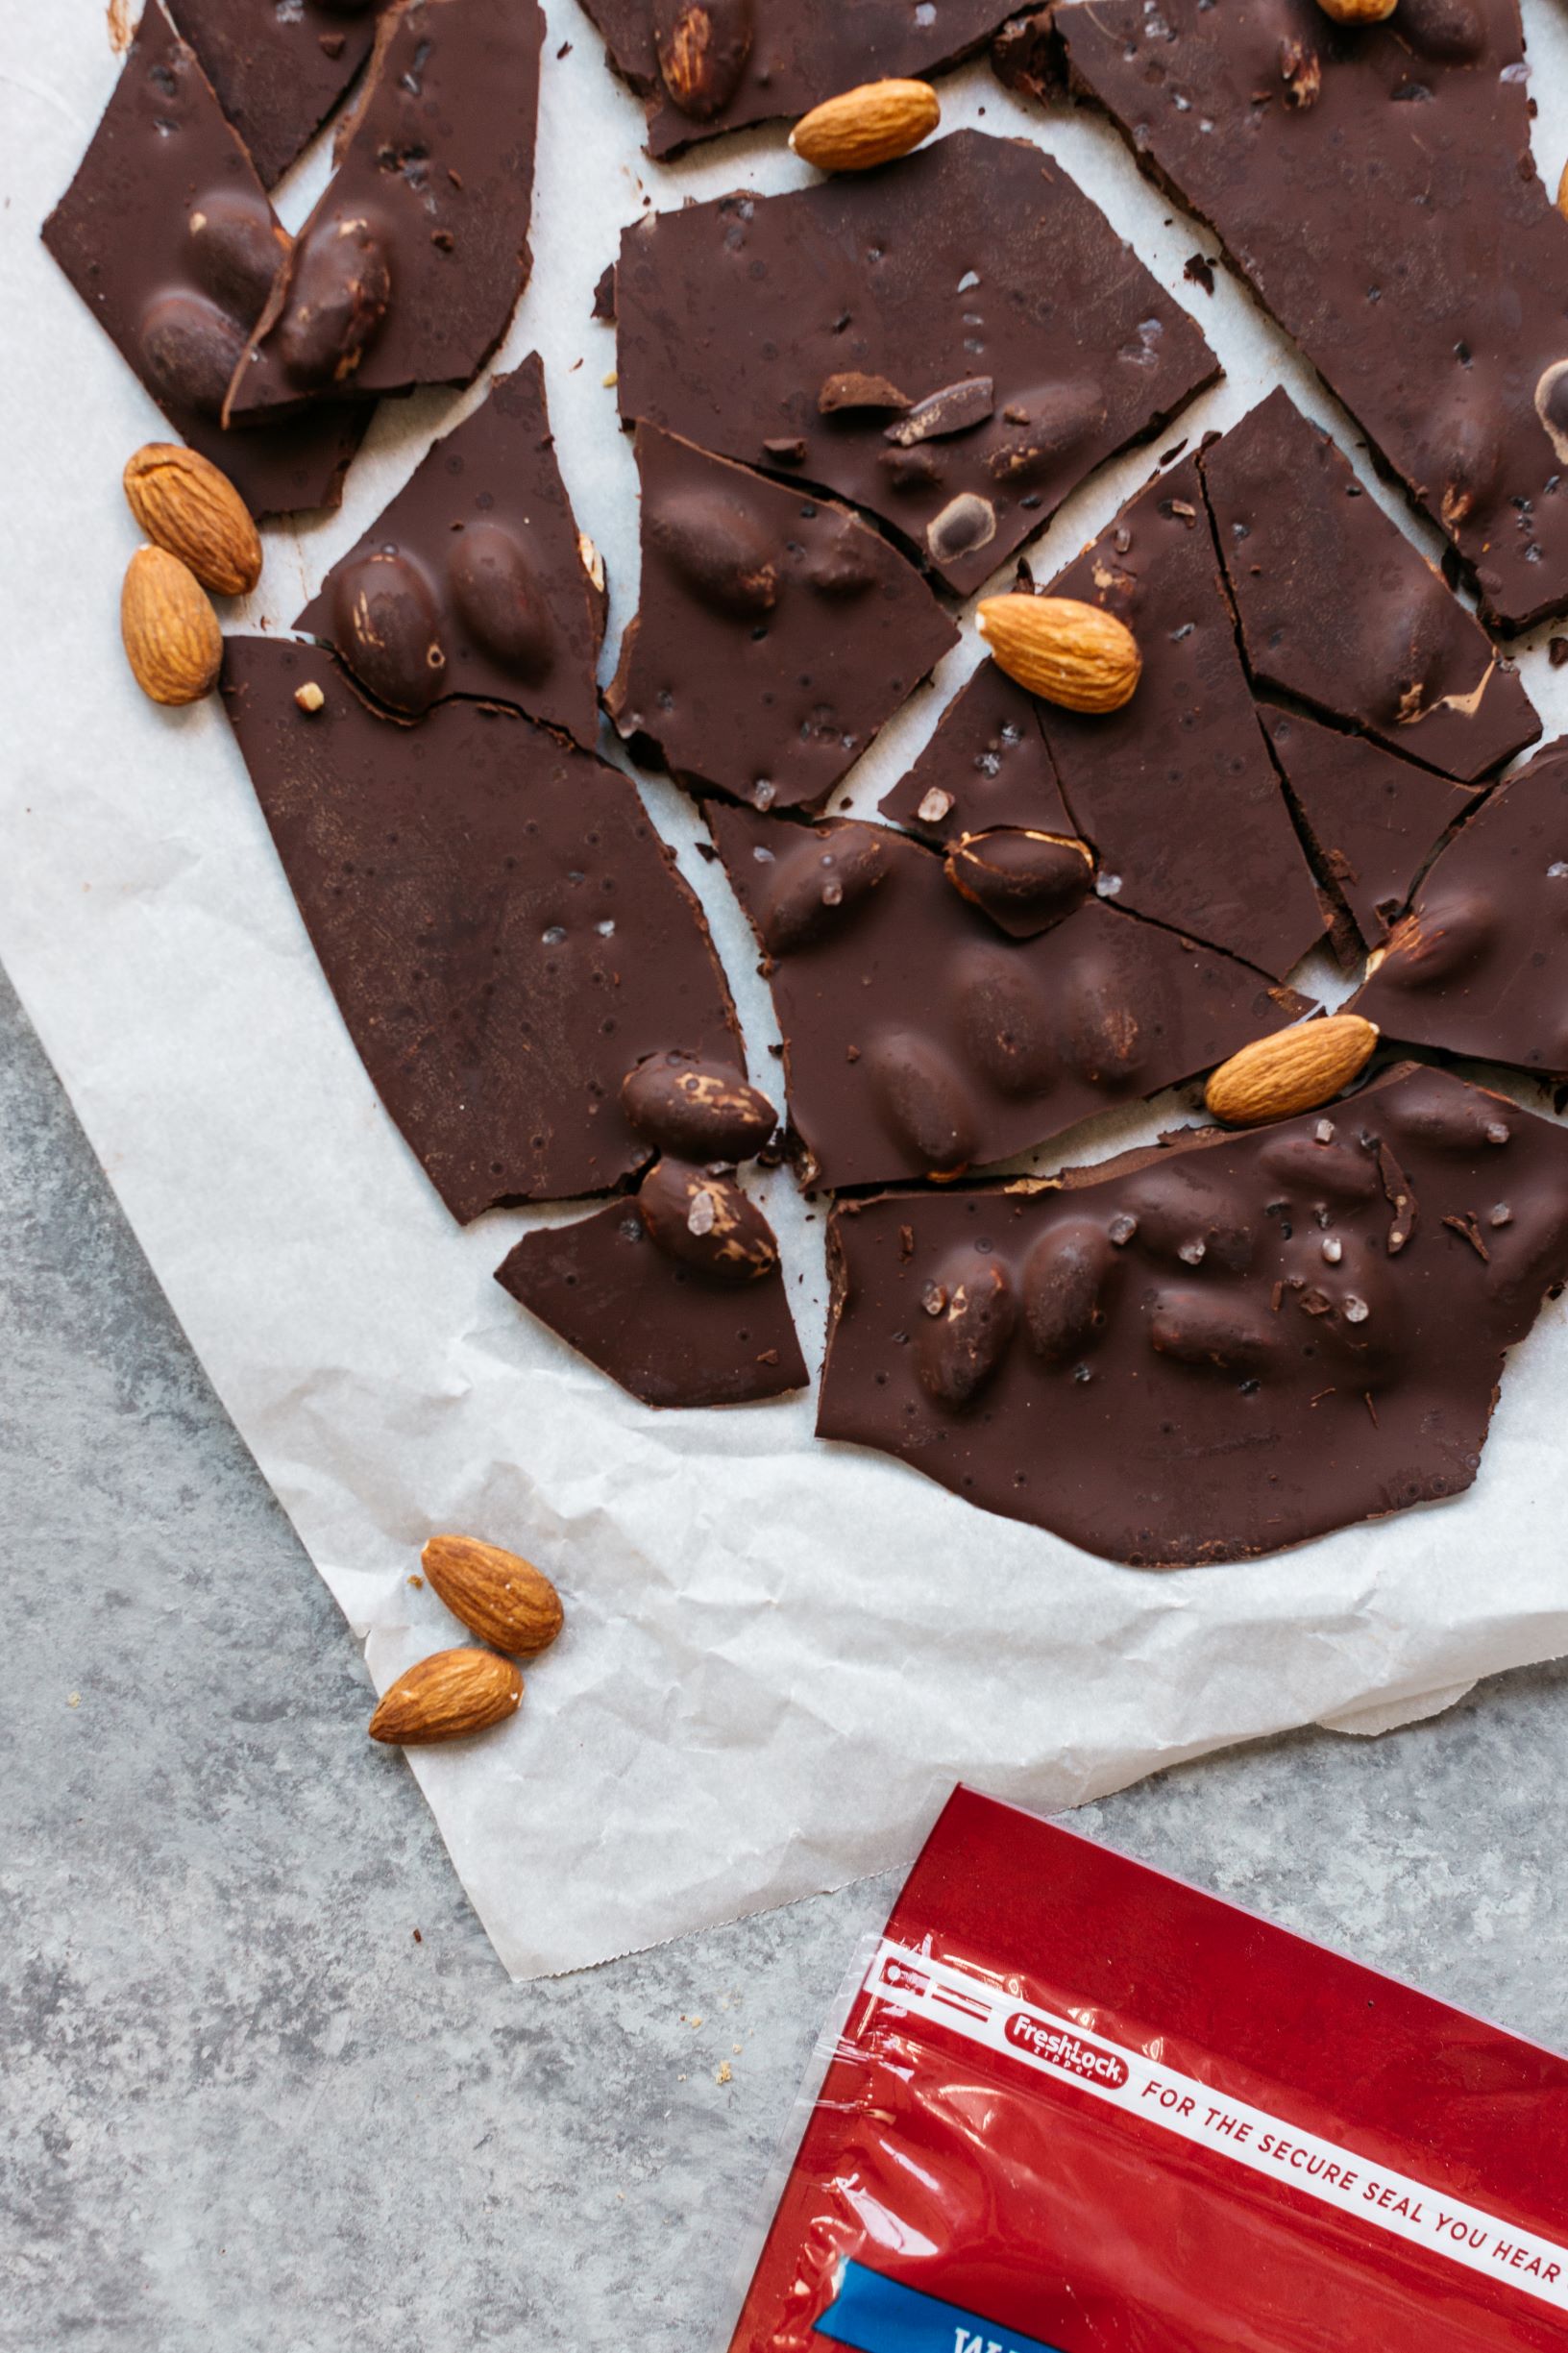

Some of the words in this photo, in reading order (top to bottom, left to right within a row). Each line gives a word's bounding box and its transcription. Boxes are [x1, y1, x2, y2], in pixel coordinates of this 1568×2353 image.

[1141, 2080, 1195, 2117] FOR
[1204, 2107, 1253, 2143] THE
[1258, 2134, 1359, 2191] SECURE
[1362, 2182, 1422, 2223] SEAL
[1435, 2213, 1487, 2248] YOU
[1492, 2241, 1561, 2283] HEAR
